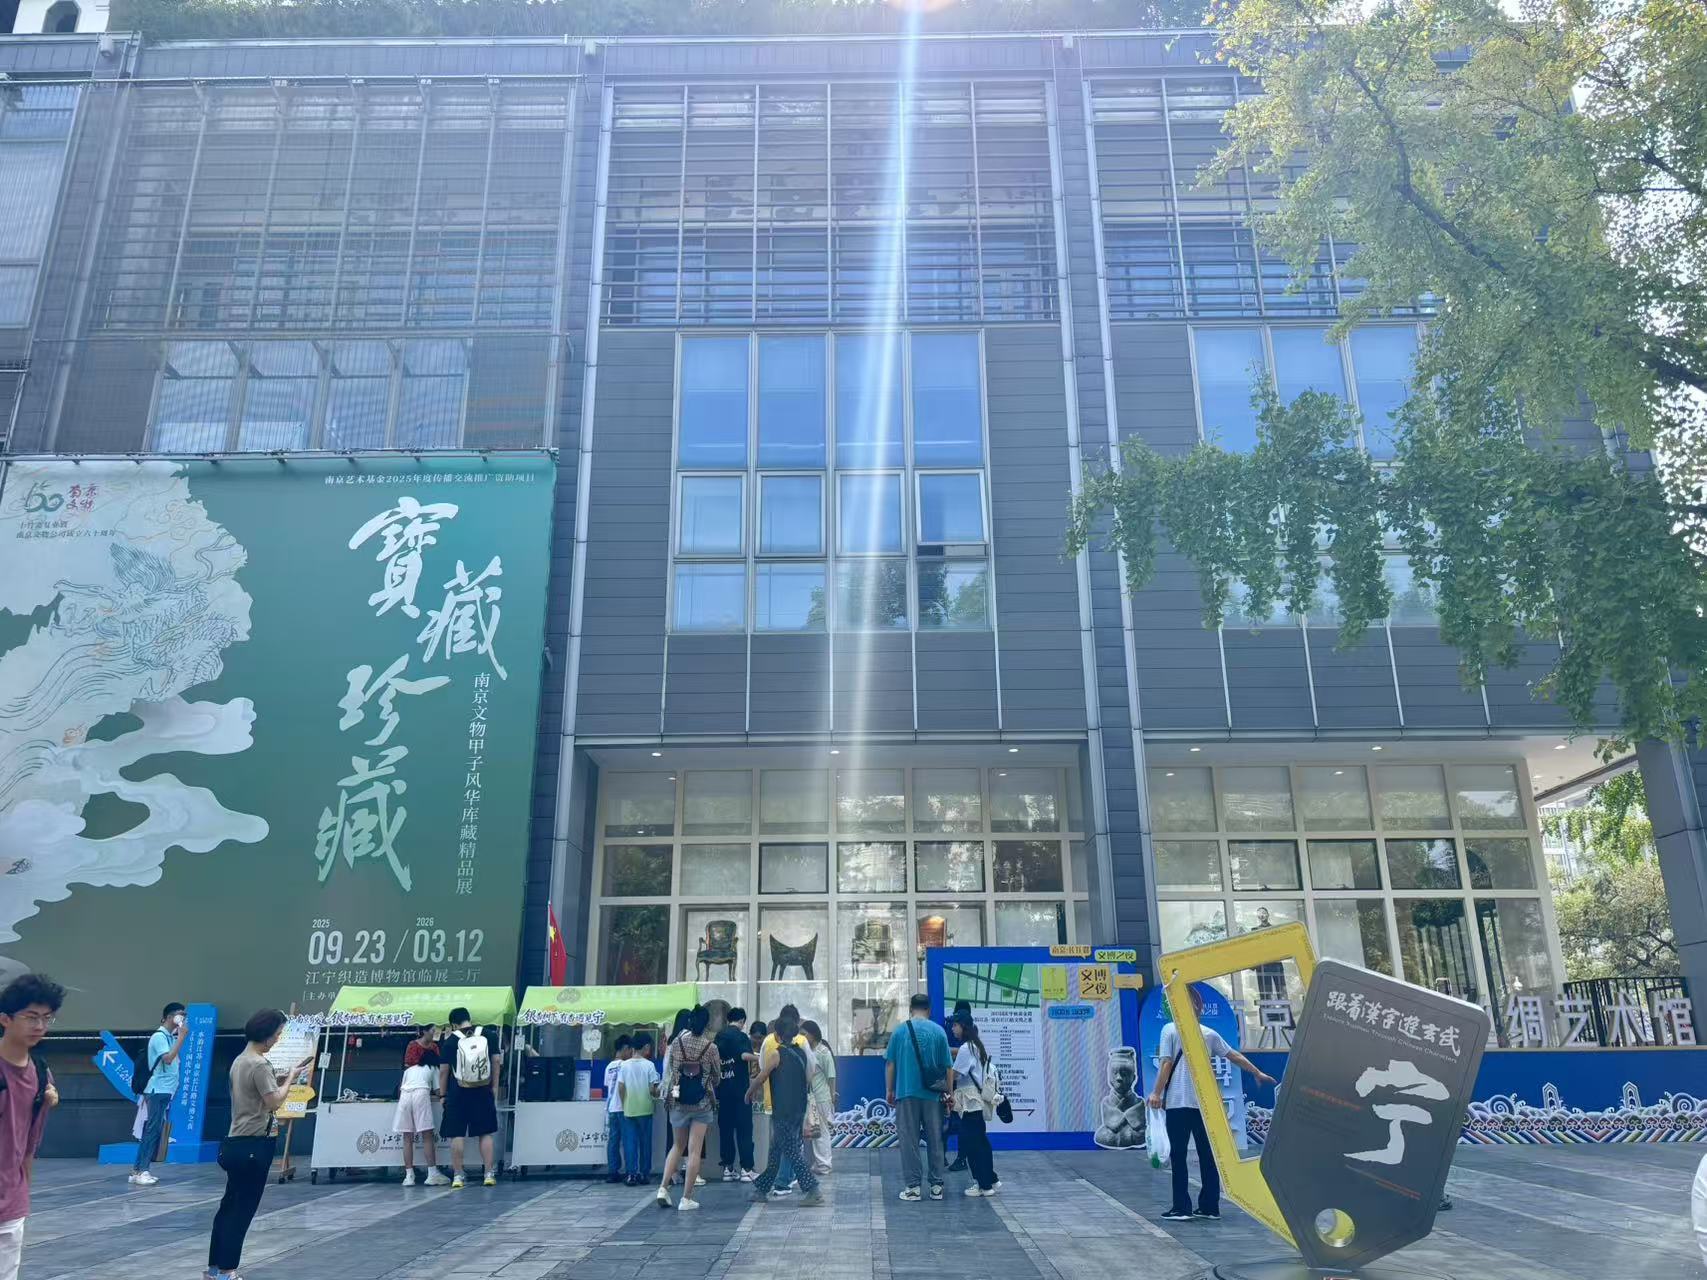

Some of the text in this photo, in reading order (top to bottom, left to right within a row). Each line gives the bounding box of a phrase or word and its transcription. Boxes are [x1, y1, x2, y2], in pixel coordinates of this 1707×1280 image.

[455, 672, 491, 895] 南京文物甲子风华库藏精品展
[312, 918, 331, 929] 2025
[416, 917, 434, 927] 2026
[308, 930, 386, 965] 09.23
[413, 929, 484, 964] 03.12
